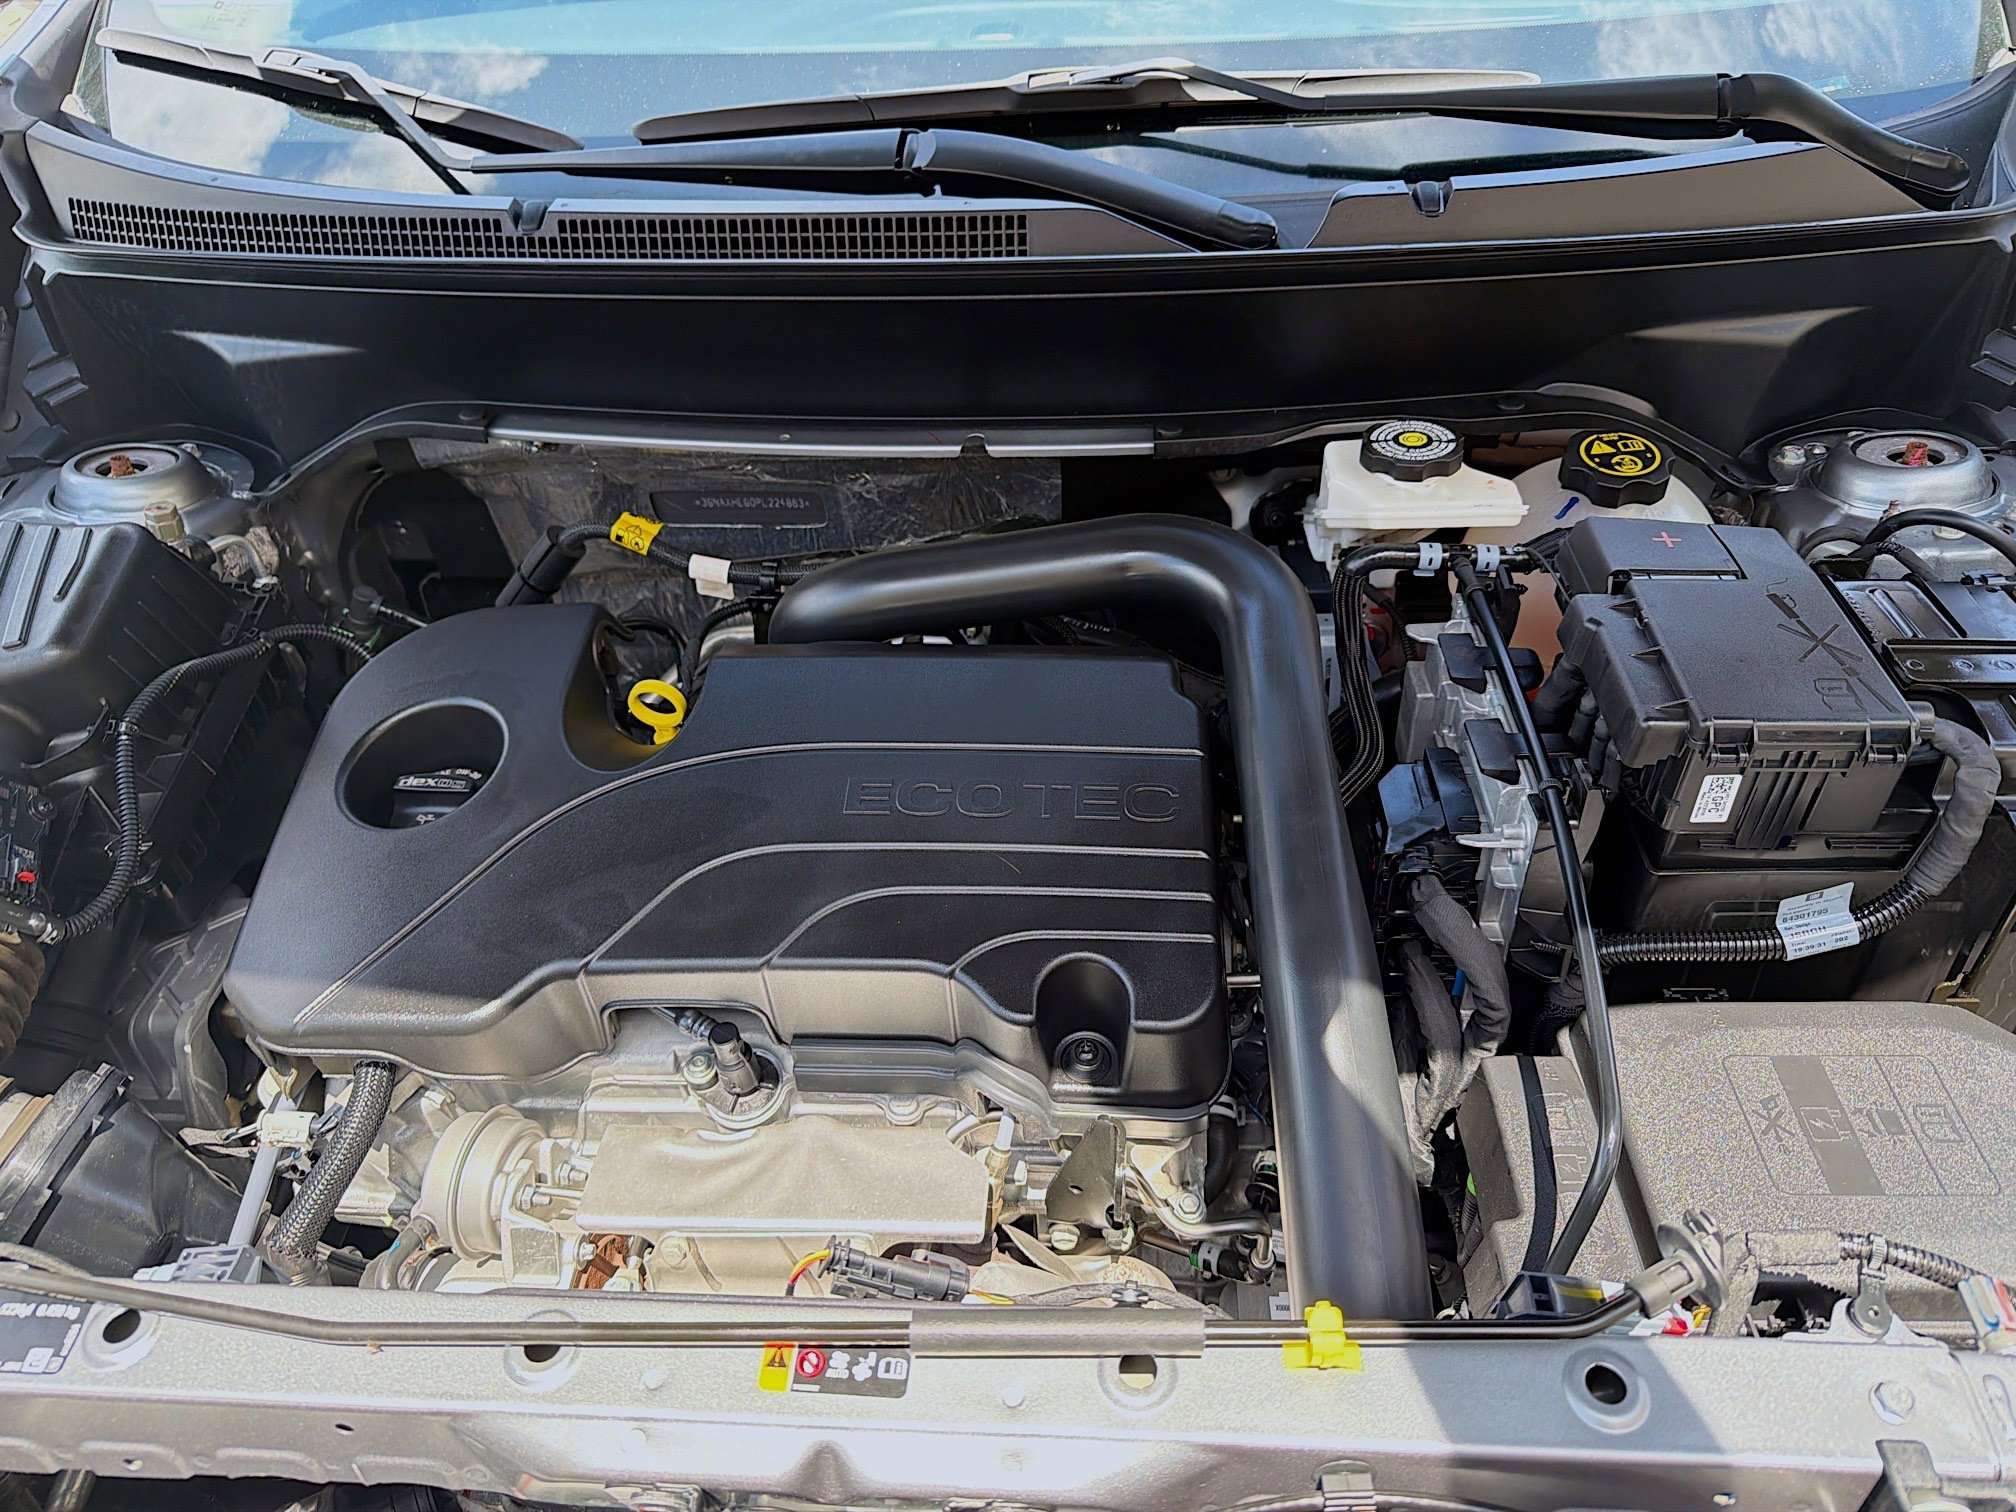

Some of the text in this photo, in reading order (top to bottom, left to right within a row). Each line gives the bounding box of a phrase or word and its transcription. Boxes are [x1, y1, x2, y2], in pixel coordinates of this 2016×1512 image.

[842, 778, 1182, 822] ECOTEC
[1708, 796, 1724, 813] GPC
[1782, 907, 1829, 923] 84301795
